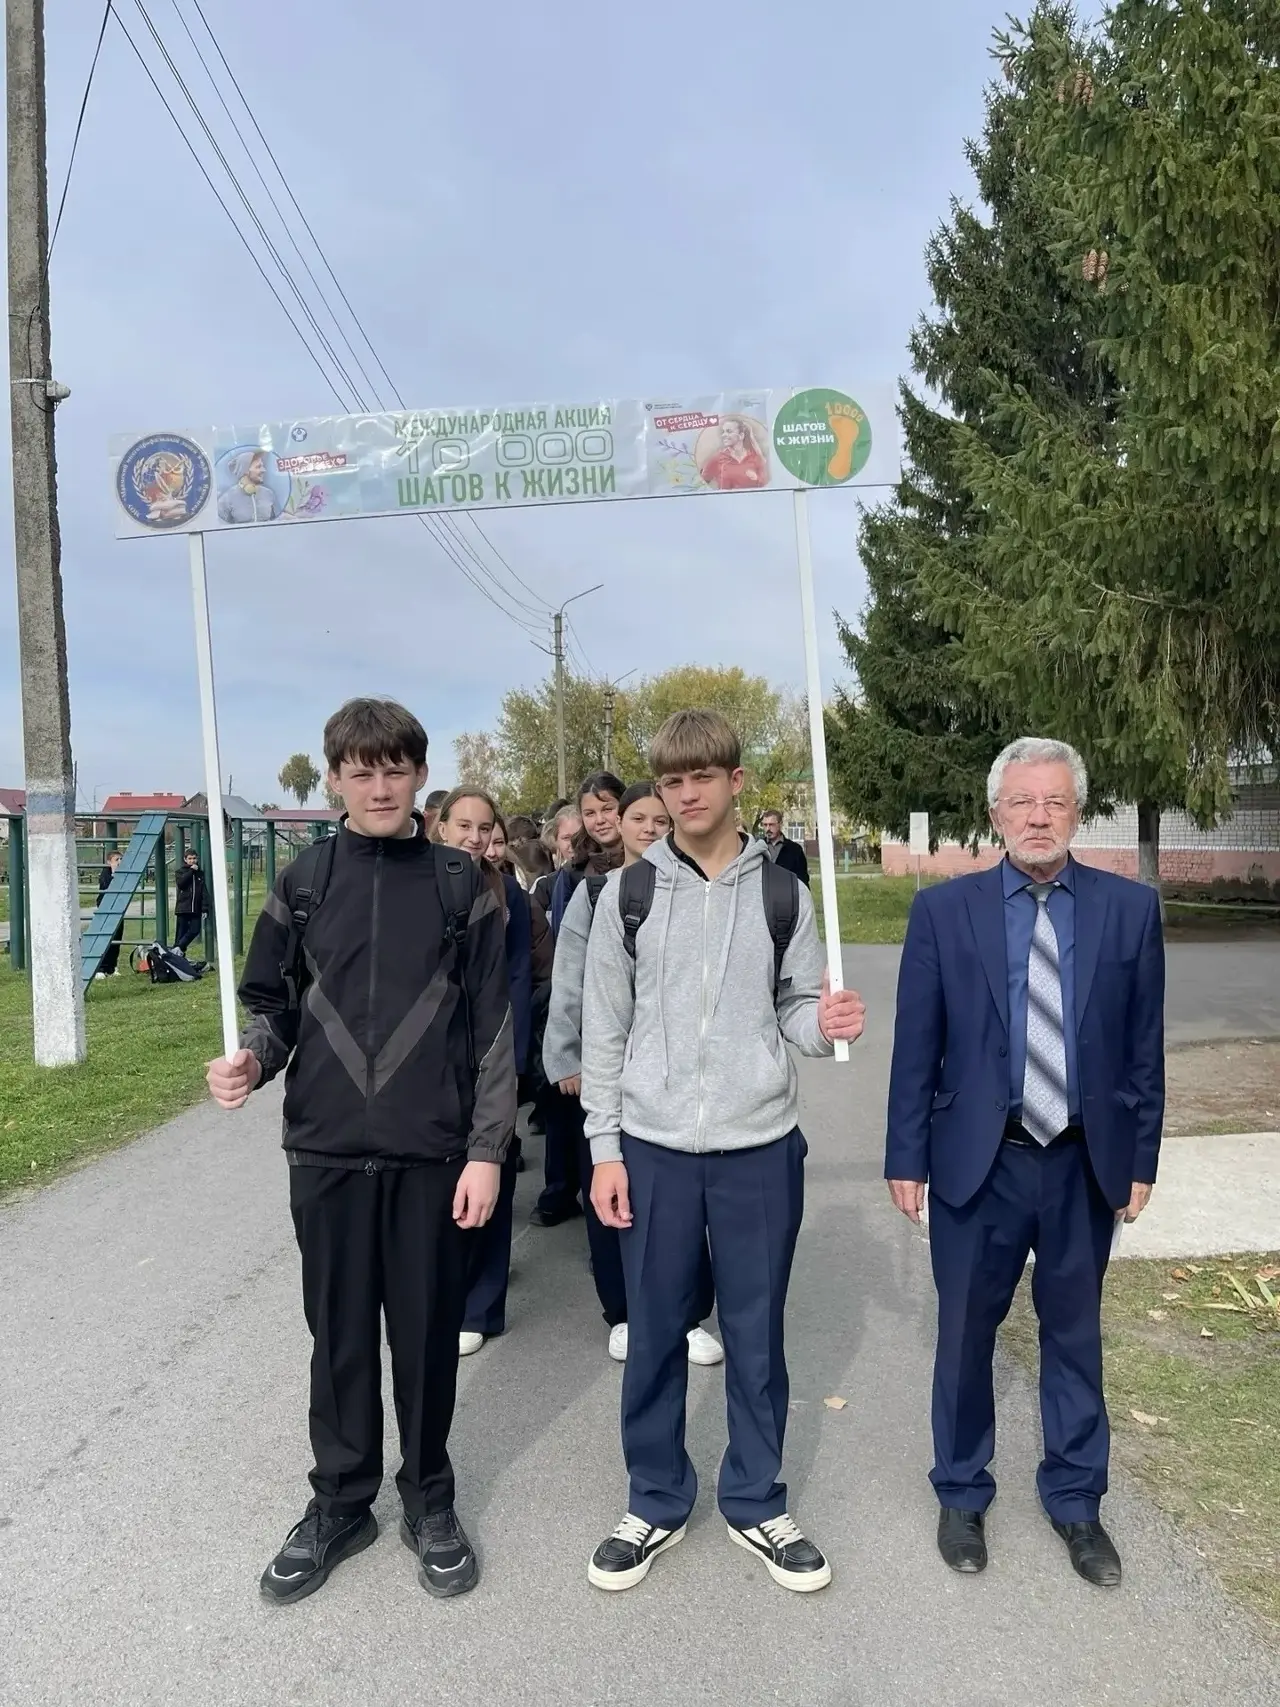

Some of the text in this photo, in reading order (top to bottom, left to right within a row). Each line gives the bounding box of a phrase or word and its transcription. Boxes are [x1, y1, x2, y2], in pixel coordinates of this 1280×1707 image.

[825, 402, 864, 422] 10000
[395, 407, 612, 437] МЕЖДУНАРОДНАЯ АКЦИЯ
[656, 414, 699, 427] ОТ СЕРДЦА
[678, 418, 708, 429] СЕРДЦУ
[783, 422, 826, 433] ШАГОВ
[776, 434, 835, 446] К ЖИЗНИ
[396, 429, 614, 474] 10 000
[397, 465, 616, 507] ШАГОВ К ЖИЗНИ
